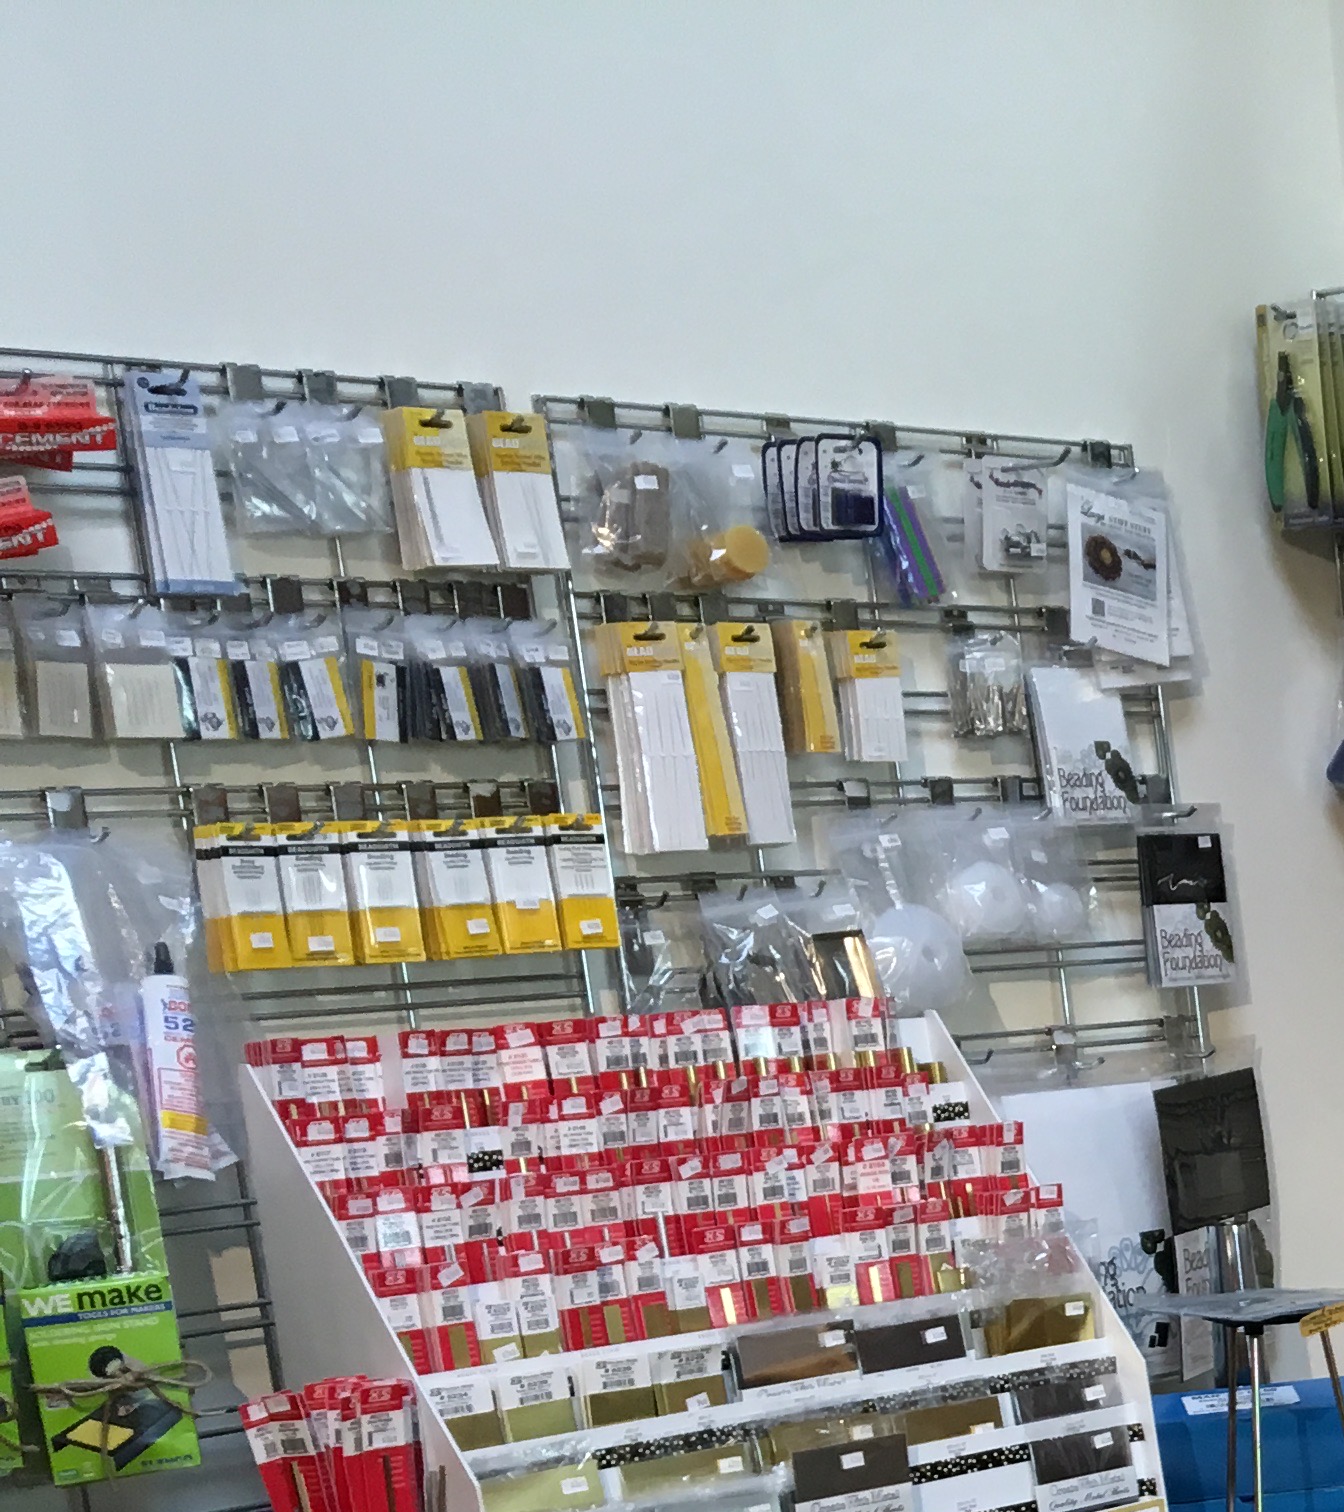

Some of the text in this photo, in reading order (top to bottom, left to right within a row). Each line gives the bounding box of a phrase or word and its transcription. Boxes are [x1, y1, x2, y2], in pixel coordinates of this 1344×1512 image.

[1058, 768, 1106, 793] Beading
[1061, 790, 1127, 814] Foundation
[1159, 928, 1204, 951] Beading
[1163, 950, 1223, 977] Foundation
[21, 1283, 163, 1317] WE make
